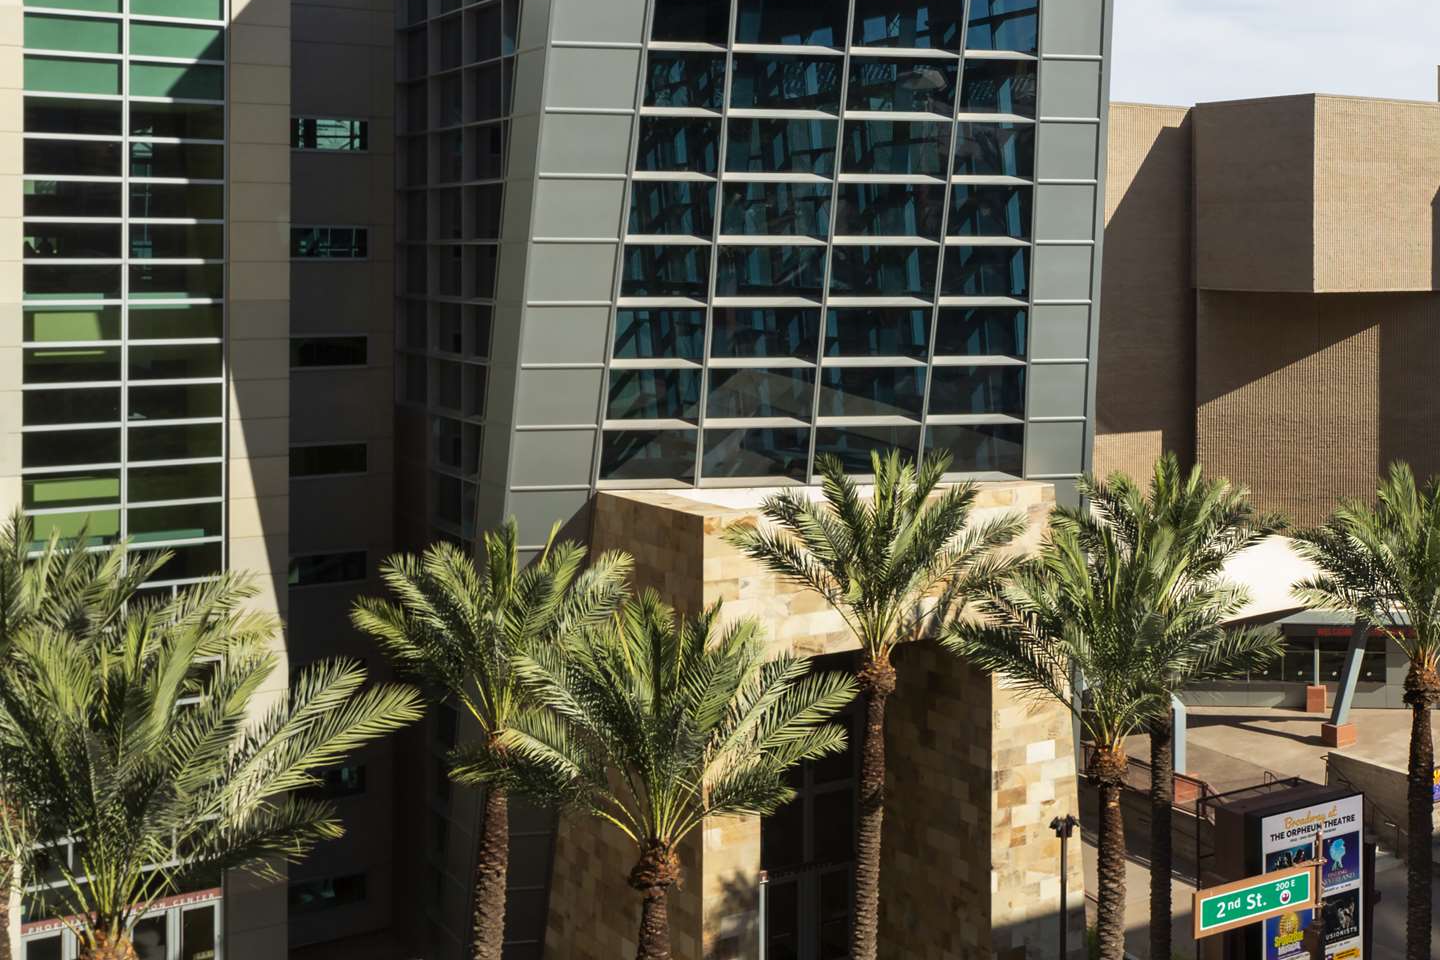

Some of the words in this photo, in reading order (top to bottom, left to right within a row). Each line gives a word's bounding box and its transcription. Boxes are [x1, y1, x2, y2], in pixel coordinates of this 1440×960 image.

[1270, 831, 1285, 842] THE
[1286, 824, 1322, 838] ORPHEUM
[1323, 814, 1356, 828] THEATRE
[1275, 882, 1289, 891] 200
[1291, 879, 1296, 887] E
[172, 893, 216, 906] CENTER
[1216, 897, 1241, 919] 2nd
[1246, 892, 1267, 910] St.
